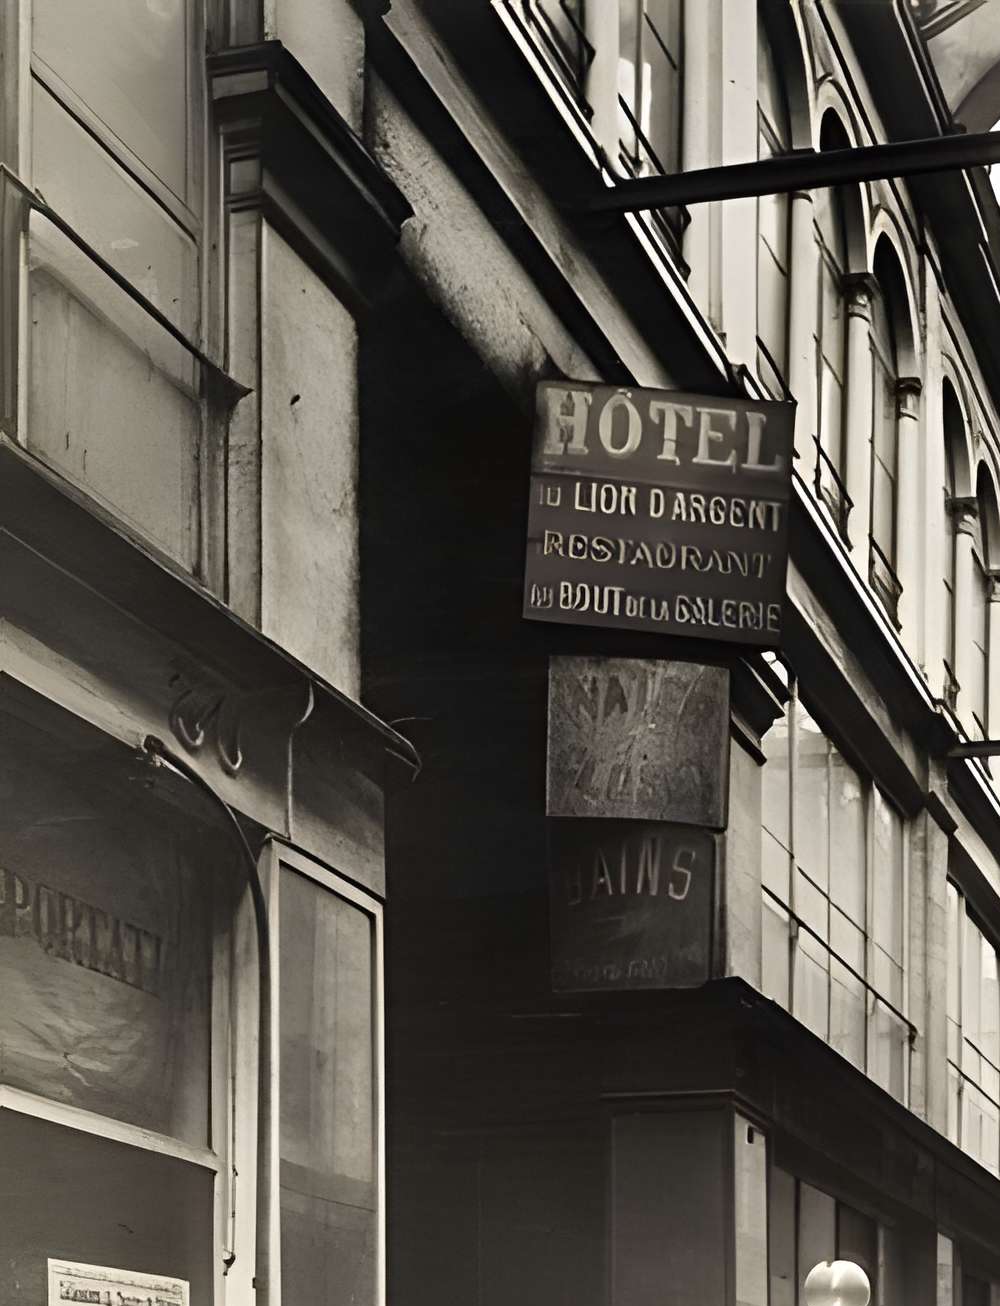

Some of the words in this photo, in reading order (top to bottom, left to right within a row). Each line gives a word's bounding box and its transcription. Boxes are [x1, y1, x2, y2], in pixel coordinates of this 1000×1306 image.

[543, 388, 782, 473] HÔTEL
[574, 482, 636, 516] LION
[560, 581, 624, 617] BOUT
